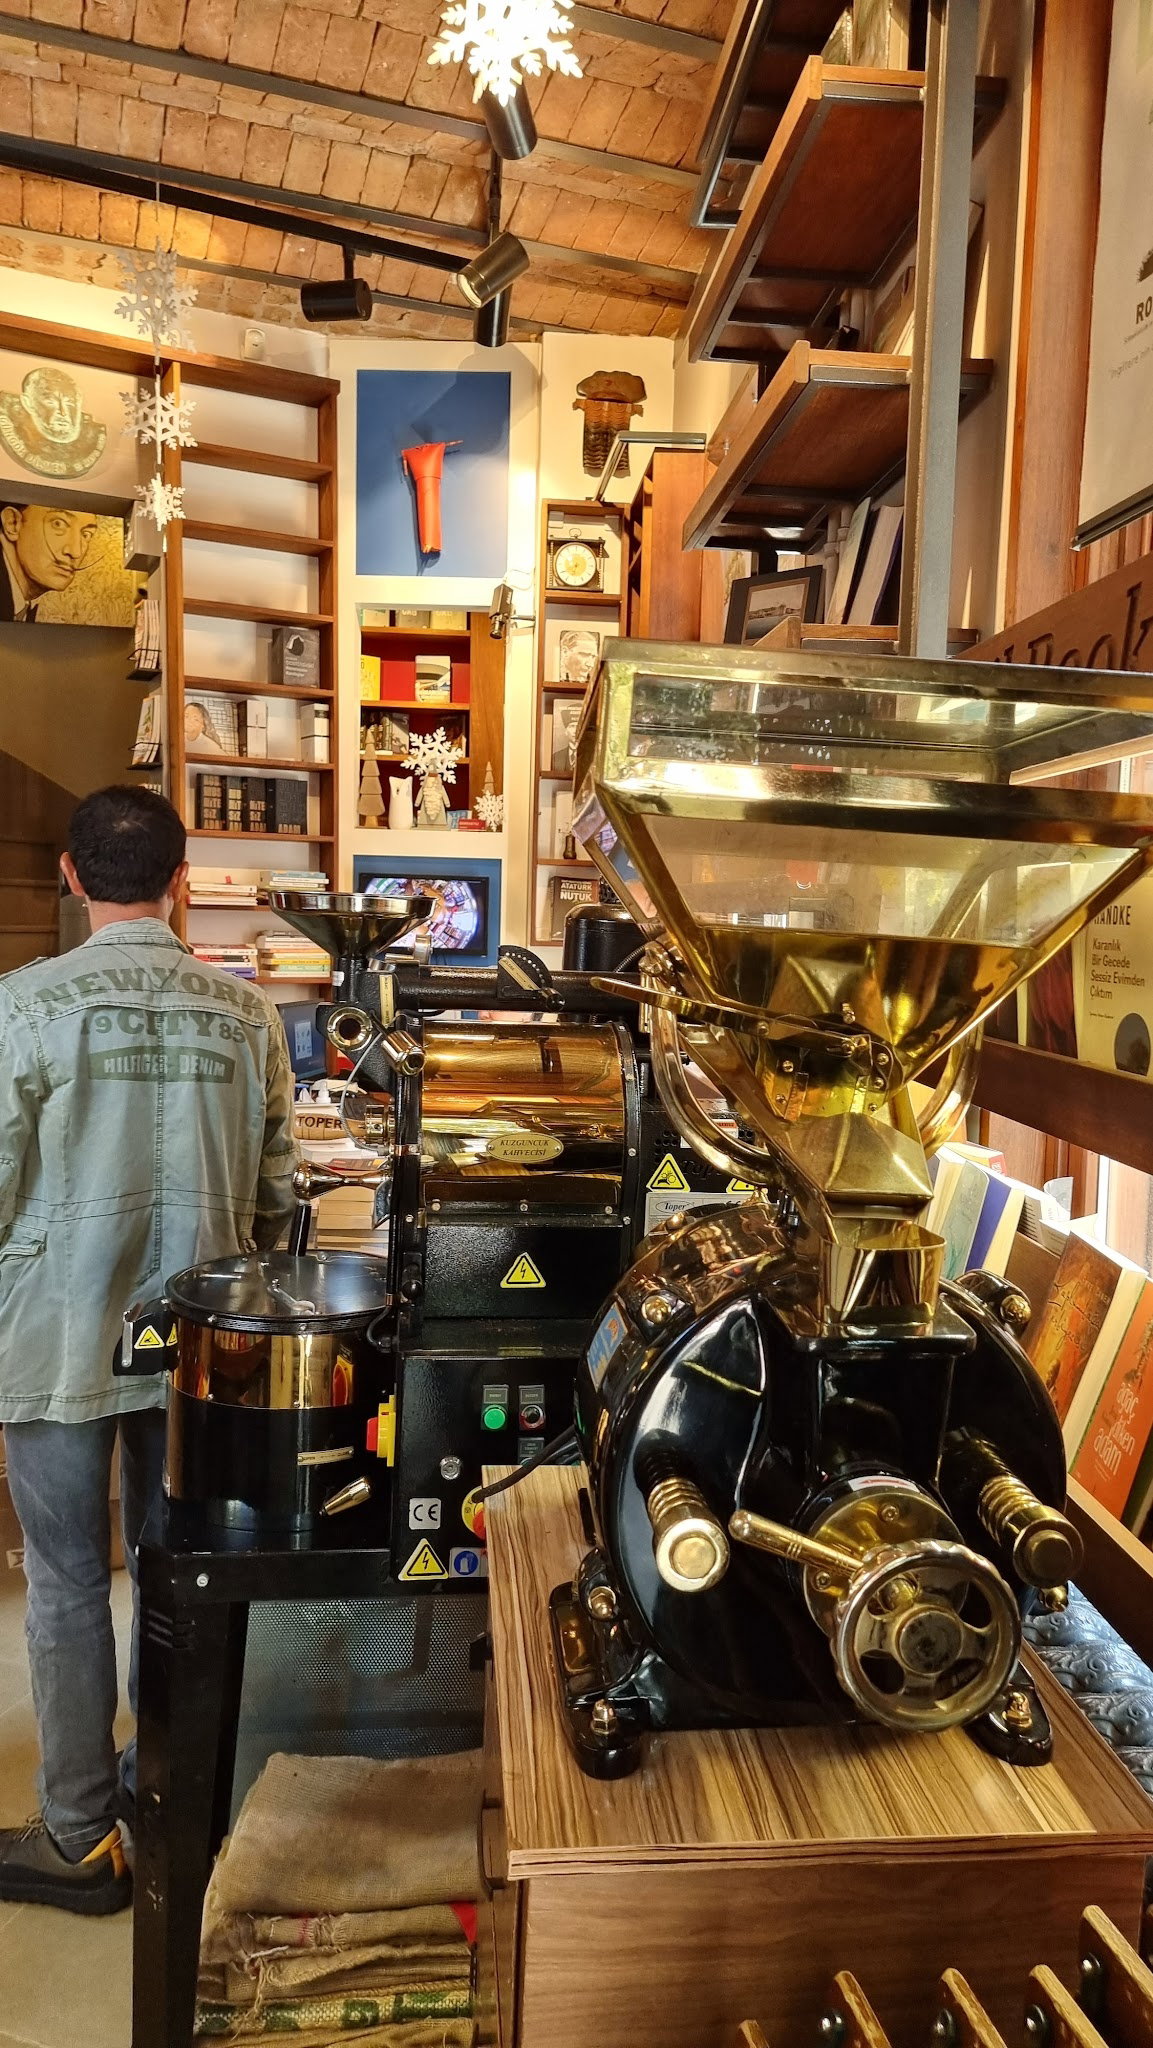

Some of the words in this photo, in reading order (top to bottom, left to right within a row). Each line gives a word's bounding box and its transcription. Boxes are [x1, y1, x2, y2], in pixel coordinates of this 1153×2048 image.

[560, 892, 592, 901] NUTUK
[1093, 938, 1121, 951] Karanlık
[1091, 953, 1101, 965] Bir
[1103, 955, 1130, 968] Gecede
[1090, 969, 1112, 984] Sessiz
[1113, 971, 1145, 986] Evimden
[35, 967, 151, 1014] NEW
[1090, 985, 1112, 1000] Çıktım
[117, 1007, 216, 1037] CITY
[218, 1022, 247, 1043] 85
[179, 1054, 227, 1077] DENIM
[296, 1115, 343, 1129] TOPER
[500, 1139, 550, 1147] KUZGUNCUK
[503, 1147, 547, 1156] KAHVECİSİ
[664, 1202, 686, 1212] Toper
[1094, 1428, 1121, 1475] adam
